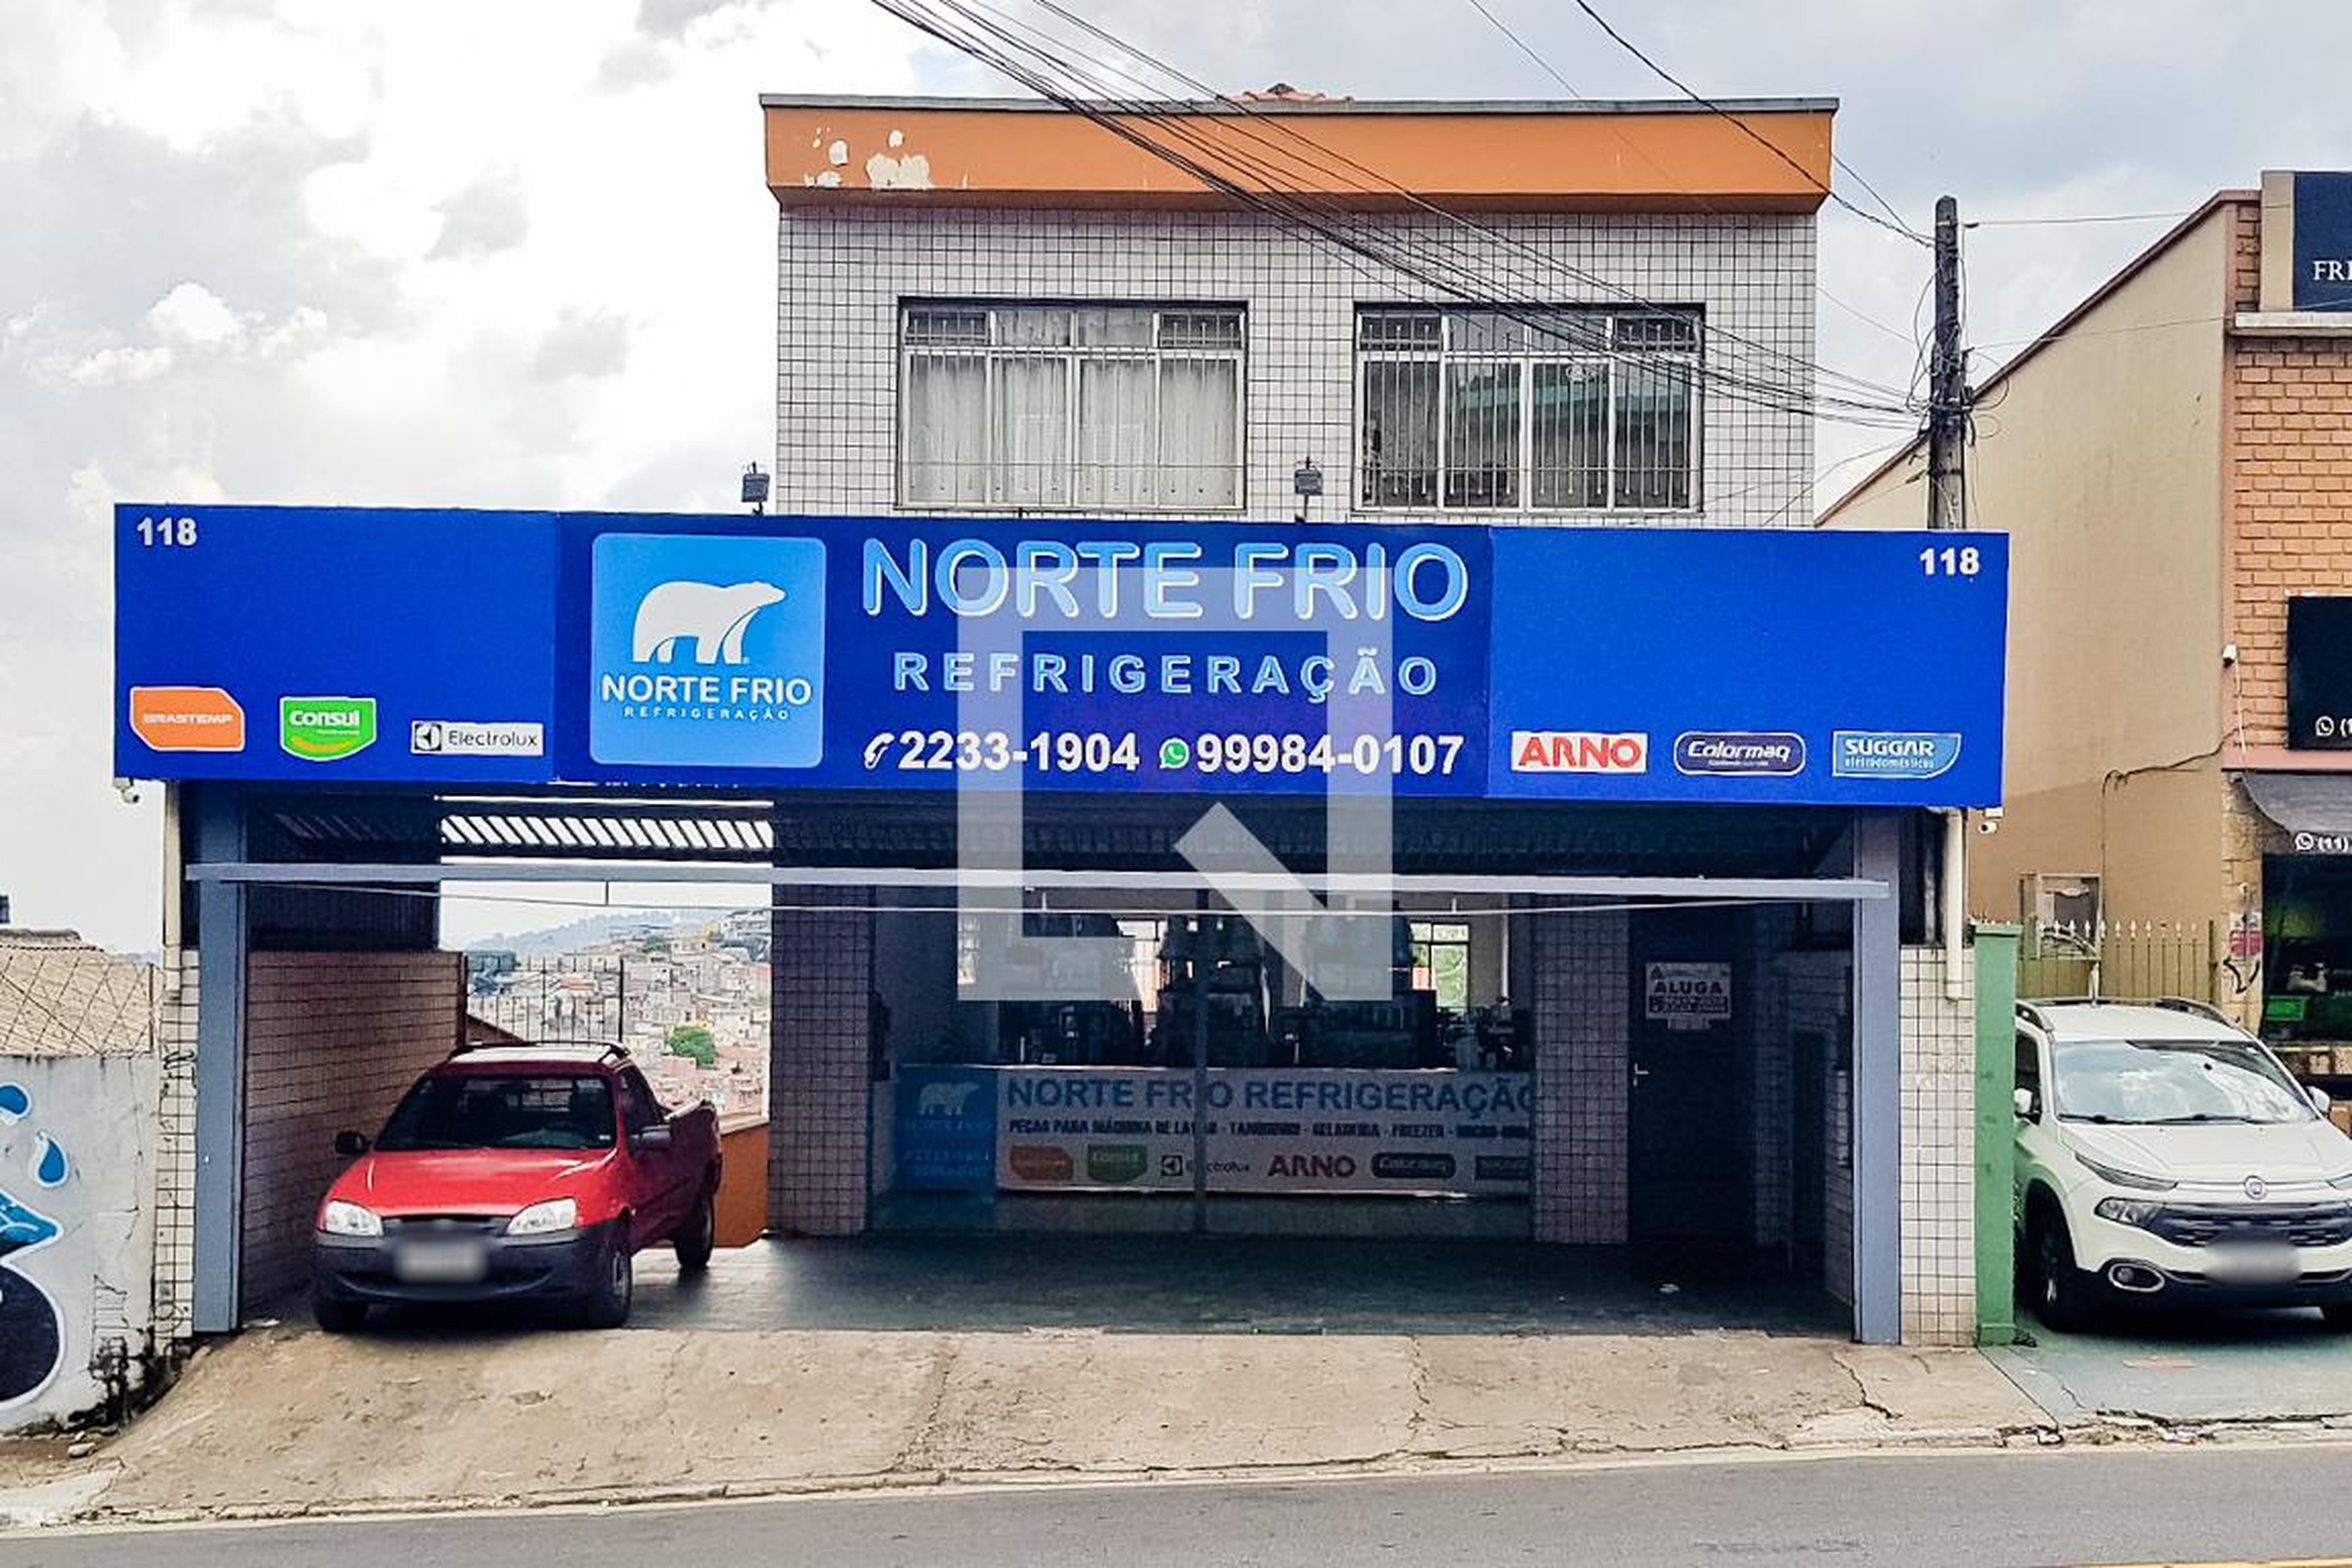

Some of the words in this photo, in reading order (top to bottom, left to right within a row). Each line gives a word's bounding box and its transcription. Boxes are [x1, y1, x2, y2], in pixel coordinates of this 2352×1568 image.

[137, 518, 197, 546] 118
[1919, 547, 1980, 575] 118
[863, 538, 1203, 617] NORTE
[1234, 542, 1468, 621] FRIO
[602, 674, 720, 703] NORTE
[731, 677, 812, 705] FRIO
[893, 647, 1438, 704] REFRIGERAÇÃO
[624, 706, 790, 722] REFRIGERAÇÃO
[448, 730, 537, 747] Electrolux
[898, 731, 1140, 772] 2233-1904
[1518, 736, 1642, 769] ARNO
[1688, 740, 1791, 763] Colormaq
[1845, 739, 1935, 756] SUGGAR
[1196, 734, 1465, 775] 99984-0107
[1654, 981, 1722, 993] ALUGA
[1008, 1079, 1135, 1108] NORTE
[1267, 1155, 1357, 1177] ARNO
